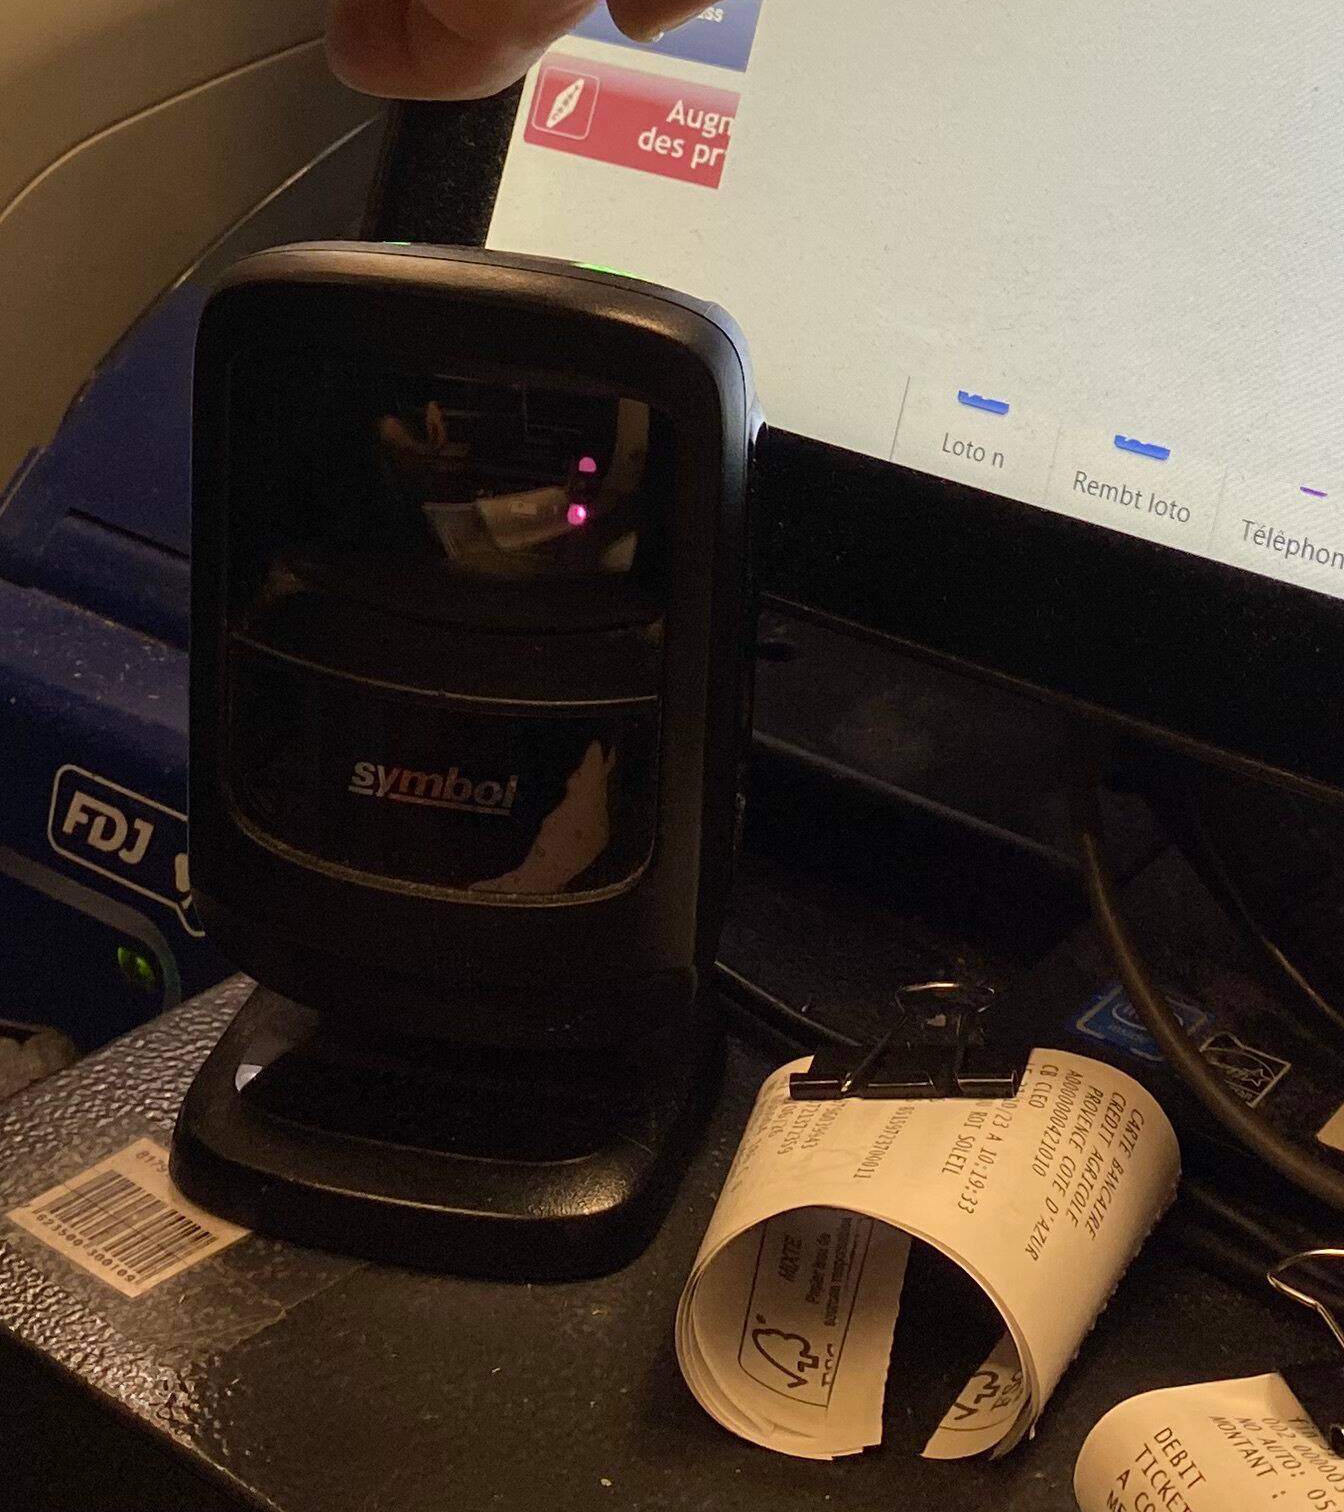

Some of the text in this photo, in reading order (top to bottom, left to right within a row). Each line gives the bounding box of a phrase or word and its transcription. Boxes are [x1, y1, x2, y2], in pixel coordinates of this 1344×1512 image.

[638, 127, 726, 170] des pr
[942, 431, 987, 467] Loto
[1072, 470, 1192, 525] Rembt loto
[350, 759, 519, 812] symbol
[61, 790, 155, 865] FDJ
[941, 1134, 976, 1176] SOLEIL
[986, 1131, 1004, 1142] A
[1066, 1091, 1127, 1228] CREDIT AGRICOLE
[958, 1146, 997, 1215] 10:19:33
[1025, 1085, 1104, 1262] PROVENCE COTE D'AZUR
[1084, 1108, 1145, 1241] CARTE BANCAIRE
[1208, 1415, 1279, 1478] MONTANT
[1234, 1416, 1263, 1432] NO
[1116, 1468, 1131, 1491] A
[1153, 1426, 1207, 1489] DEBIT
